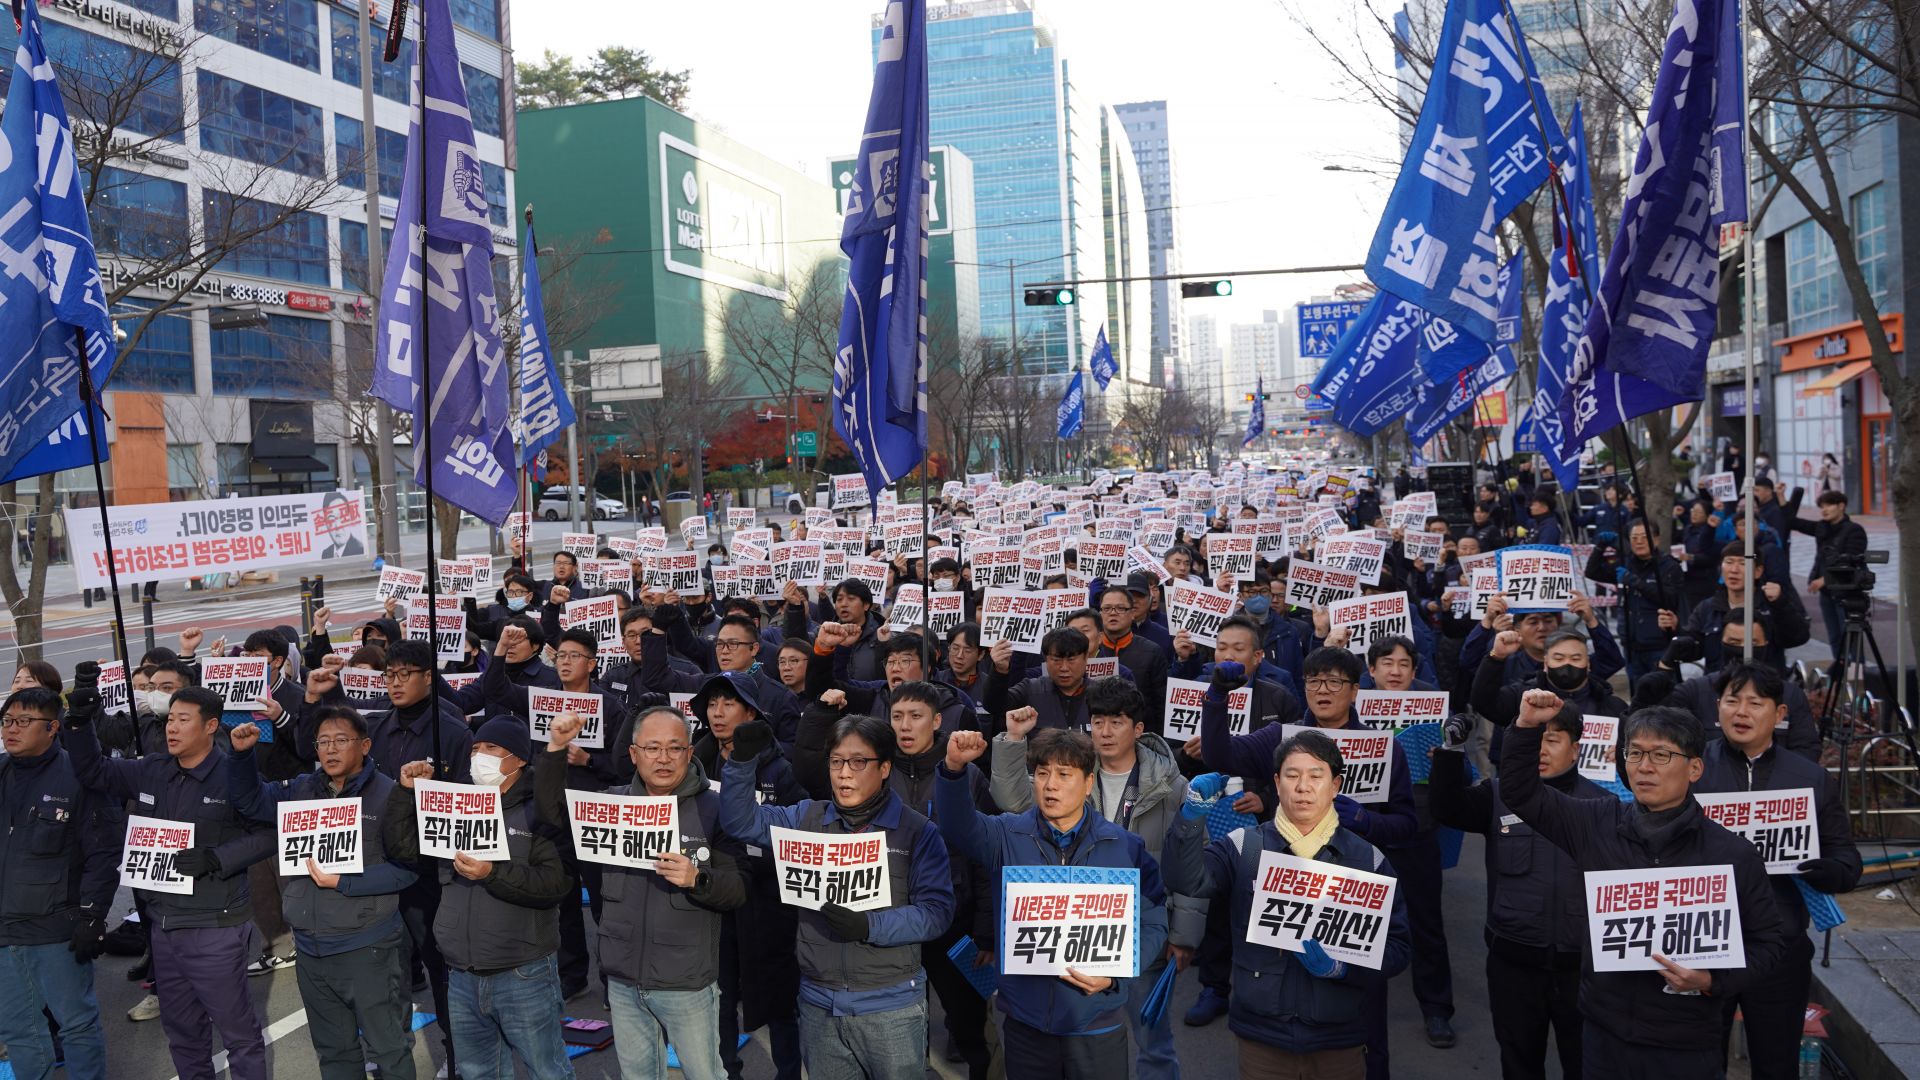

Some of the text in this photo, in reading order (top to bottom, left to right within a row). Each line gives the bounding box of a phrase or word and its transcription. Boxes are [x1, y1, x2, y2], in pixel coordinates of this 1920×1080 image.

[231, 284, 286, 305] 383-8883
[843, 531, 863, 541] 국민의힘
[902, 523, 923, 535] 국민의힘
[1038, 527, 1058, 539] 국민의힘
[1153, 523, 1174, 532] 국민의힘
[1235, 522, 1282, 534] 내란공범 국민의힘
[577, 537, 596, 545] 국민의힘
[841, 542, 861, 556] 해산!
[887, 536, 922, 555] 즉각 해산!
[1040, 540, 1061, 554] 국민의힘
[1079, 542, 1126, 557] 내란공범 국민의힘
[1148, 533, 1172, 548] 해산!
[1209, 538, 1253, 552] 내란공범 국민의힘
[1256, 535, 1282, 552] 해산!
[1326, 541, 1382, 557] 내란공범 국민의힘
[658, 555, 697, 570] 내란공범 국민의힘
[772, 545, 821, 563] 내란공범 국민의힘
[824, 553, 844, 564] 국민의힘
[973, 550, 1020, 565] 내란공범 국민의힘
[453, 564, 473, 574] 국민의힘
[739, 565, 754, 576] 내란공범
[774, 560, 820, 583] 즉각 해산!
[823, 566, 844, 581] 해산!
[863, 564, 886, 578] 국민의힘
[1080, 557, 1095, 576] 즉각
[1095, 559, 1125, 578] 해산!
[1210, 555, 1252, 573] 즉각 해산!
[1346, 557, 1379, 577] 해산!
[1506, 557, 1570, 576] 내란공범 국민의힘
[399, 574, 423, 585] 국민의힘
[584, 574, 598, 585] 즉각
[609, 569, 631, 579] 국민의힘
[661, 570, 698, 590] 즉각 해산!
[975, 565, 1021, 586] 즉각 해산!
[1291, 566, 1357, 588] 내란공범 국민의힘
[452, 577, 473, 592] 해산!
[716, 582, 725, 596] 즉각
[740, 579, 753, 595] 즉각
[1291, 582, 1317, 603] 즉각
[1506, 577, 1573, 601] 즉각 해산!
[434, 599, 458, 609] 국민의힘
[934, 596, 961, 610] 국민의힘
[985, 597, 1044, 615] 내란공범 국민의힘
[1058, 593, 1085, 608] 국민의힘
[1173, 587, 1232, 614] 내란공범 국민의힘
[569, 600, 614, 623] 내란공범 국민의힘
[890, 605, 922, 625] 해산!
[1171, 605, 1188, 629] 즉각
[1334, 597, 1404, 625] 내란공범 국민의힘
[984, 616, 1041, 643] 즉각 해산!
[205, 660, 264, 686] 내란공범 국민의힘
[231, 679, 263, 703] 해산!
[342, 674, 369, 695] 내란공범
[533, 695, 599, 714] 내란공범 국민의힘
[1360, 698, 1444, 716] 내란공범 국민의힘
[420, 791, 495, 814] 내란공범 국민의힘
[1754, 797, 1808, 824] 국민의힘
[282, 805, 358, 833] 내란공범 국민의힘
[575, 801, 672, 826] 내란공범 국민의힘
[128, 826, 190, 849] 내란공범 국민의힘
[424, 817, 499, 851] 즉각 해산!
[581, 826, 673, 861] 즉각 해산!
[1753, 825, 1811, 862] 해산!
[285, 830, 357, 867] 즉각 해산!
[779, 839, 824, 865] 내란공범
[827, 840, 880, 866] 국민의힘
[125, 851, 151, 880] 즉각
[785, 866, 882, 904] 즉각 해산!
[1263, 867, 1389, 910] 내란공범 국민의힘
[1596, 874, 1728, 914] 내란공범 국민의힘
[1012, 894, 1128, 921] 내란공범 국민의힘
[1258, 898, 1383, 952] 즉각 해산!
[1602, 915, 1656, 960] 즉각
[1662, 909, 1731, 956] 해산!
[1013, 924, 1127, 964] 즉각 해산!
